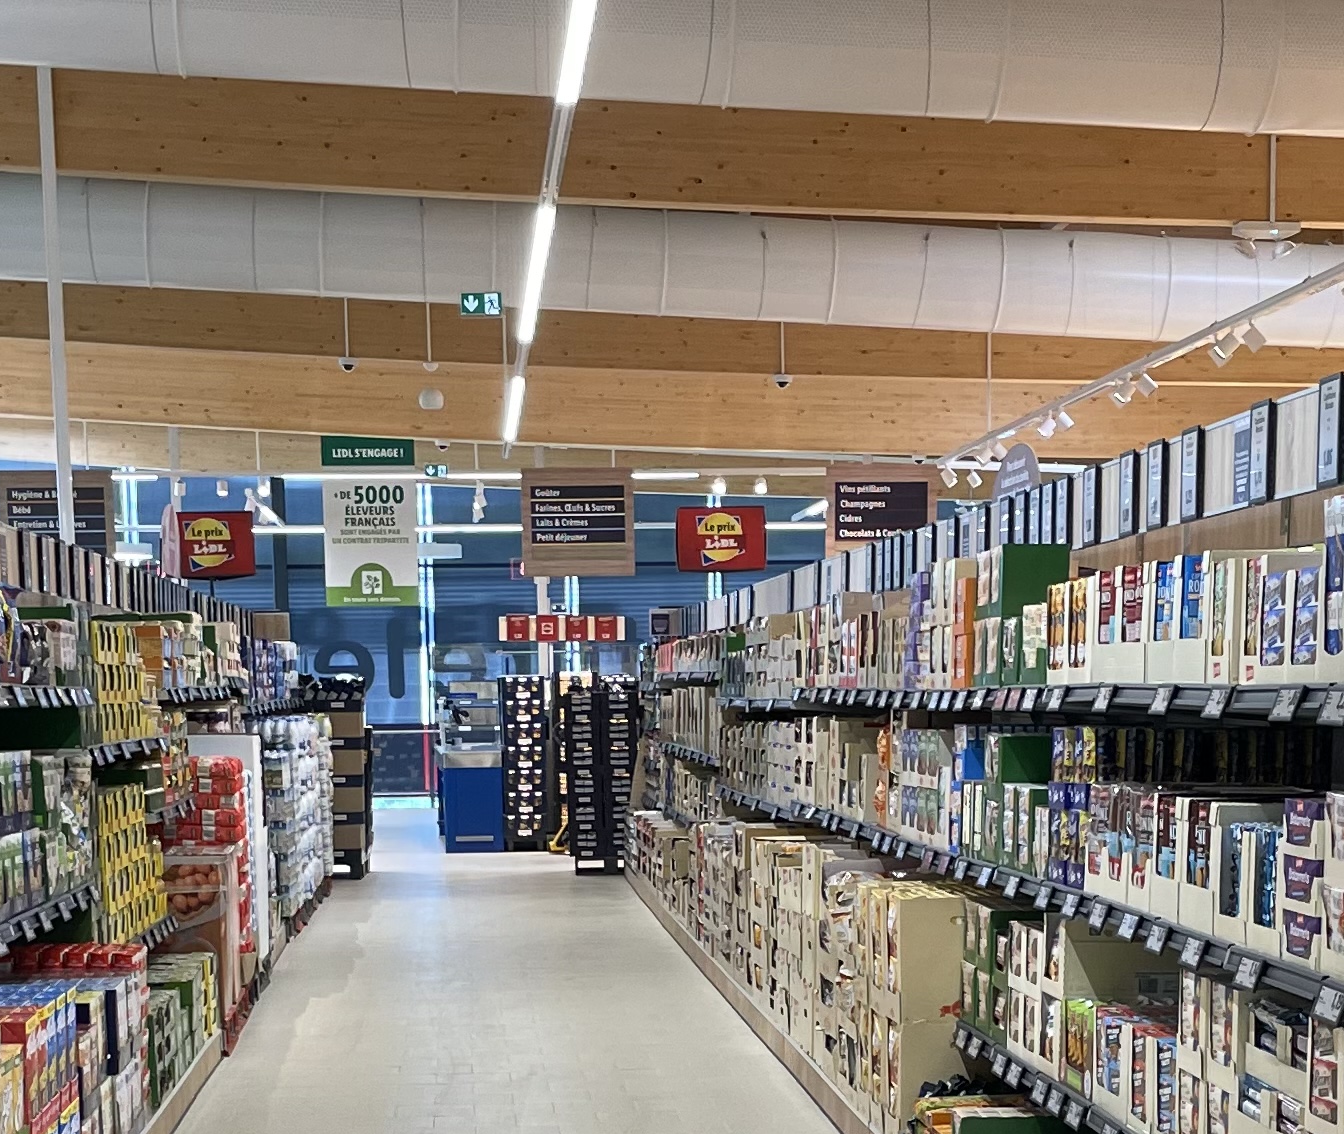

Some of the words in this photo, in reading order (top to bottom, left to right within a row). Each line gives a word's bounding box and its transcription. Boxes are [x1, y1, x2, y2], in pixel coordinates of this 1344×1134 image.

[332, 448, 354, 459] LIDL
[354, 447, 399, 459] S'ENGAGE
[535, 488, 560, 498] Goûter
[839, 485, 856, 493] Vins
[11, 490, 43, 501] Hygiène
[340, 490, 352, 500] DE
[354, 485, 405, 505] 5000
[11, 504, 32, 515] Bébé
[344, 503, 395, 516] ÉLEVEURS
[585, 503, 591, 512] &
[592, 503, 616, 512] Sucres
[840, 500, 886, 510] Champagnes
[344, 517, 397, 530] FRANÇAIS
[536, 518, 553, 527] Laits
[554, 518, 560, 527] &
[561, 517, 589, 527] Crèmes
[839, 514, 863, 523] Cidres
[13, 519, 48, 529] Entretien
[704, 522, 716, 532] Le
[717, 522, 736, 533] prix
[191, 527, 202, 538] Le
[204, 527, 224, 541] prix
[536, 533, 554, 542] Petit
[555, 533, 588, 543] déjeuner
[839, 529, 875, 538] Chocolats
[875, 529, 882, 538] &
